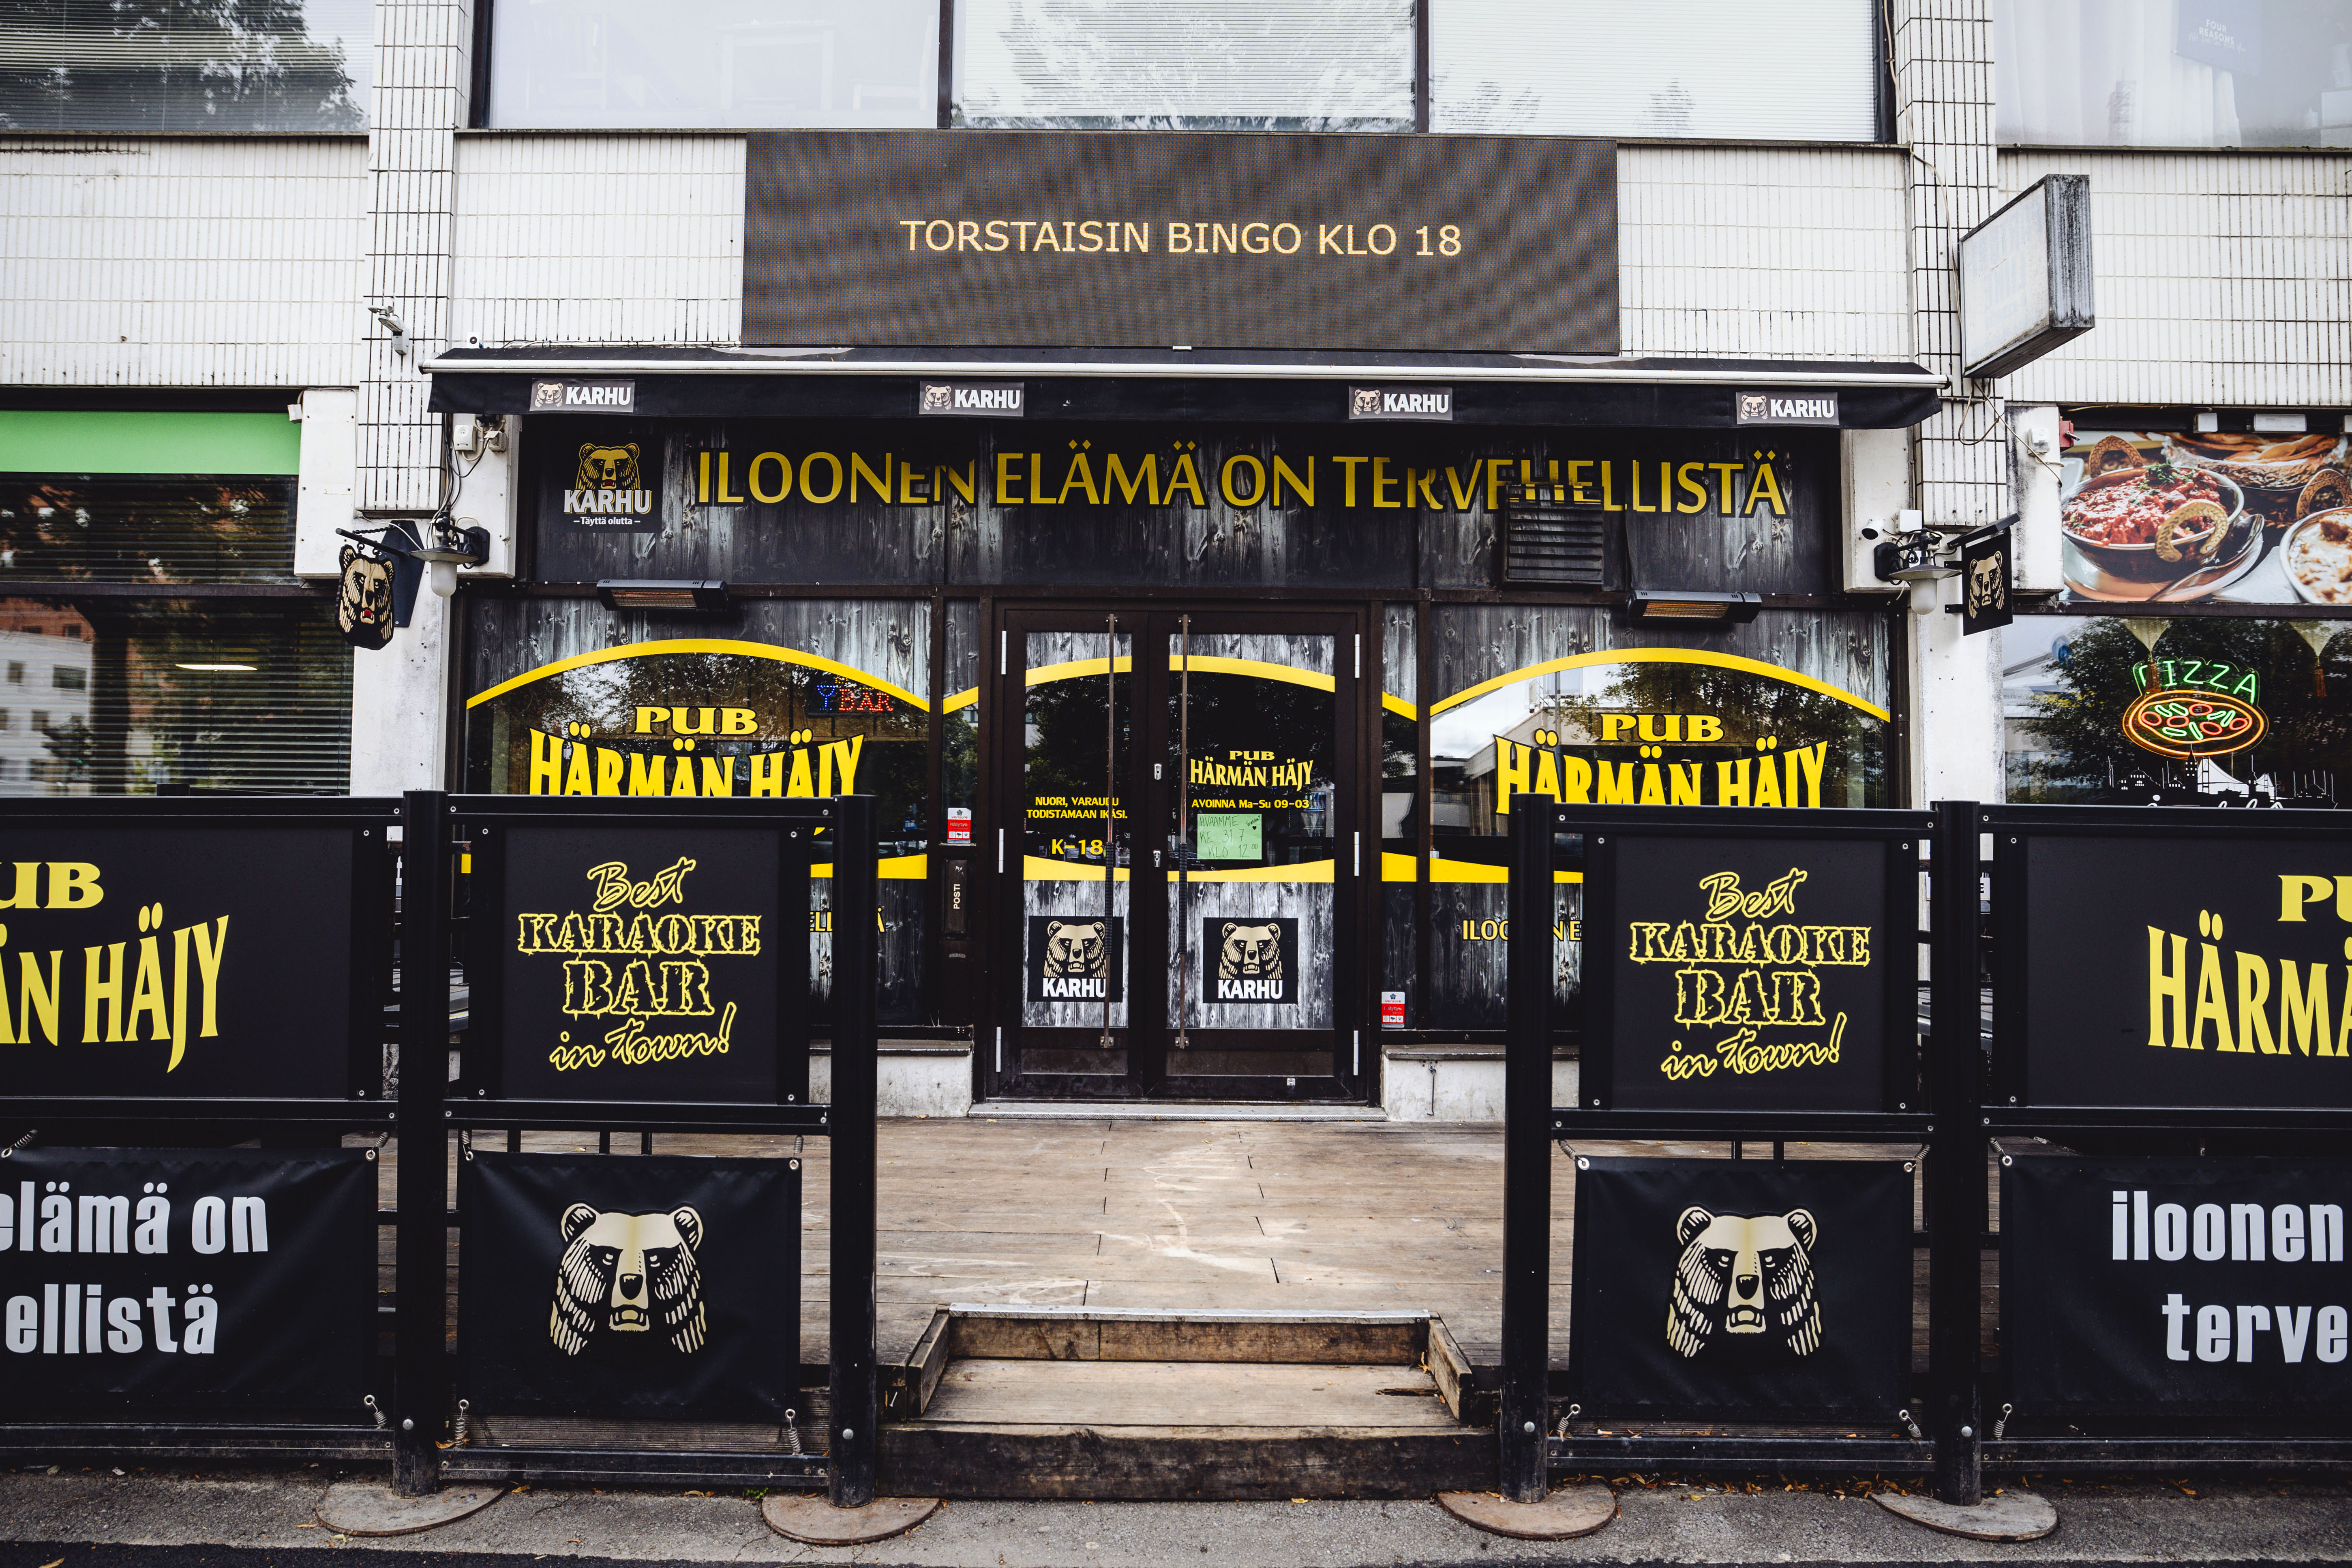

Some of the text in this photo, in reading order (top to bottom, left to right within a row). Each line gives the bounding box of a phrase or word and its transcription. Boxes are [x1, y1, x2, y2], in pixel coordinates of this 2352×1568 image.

[2199, 27, 2234, 45] REASONS
[2206, 19, 2227, 33] FOUR
[900, 219, 1462, 256] TORSTAISIN BINGO KLO 18
[565, 387, 631, 405] KARHU
[954, 389, 1021, 409] KARHU
[1384, 394, 1449, 413] KARHU
[1770, 399, 1835, 418] KARHU
[699, 451, 975, 503] ILOONEN
[996, 439, 1205, 506] ELÄMÄ
[1221, 454, 1315, 507] ON
[564, 490, 652, 514] KARHU
[839, 688, 894, 712] BAR
[635, 706, 758, 735] PUB
[1600, 713, 1724, 742] PUB
[529, 722, 734, 797] HÄRMÄN
[1229, 750, 1275, 760] PUB
[1190, 756, 1314, 792] HÄRMÄN HÄJY
[1495, 730, 1703, 814] HÄRMÄN
[1026, 809, 1097, 818] TODISTAMAAN
[1035, 797, 1069, 808] NUORI,
[1191, 799, 1310, 809] AVOINNA Ma-Su 09-03
[1200, 815, 1240, 827] AVAAMME
[1051, 838, 1103, 855] K-18
[1200, 829, 1244, 844] KE 31 7
[1208, 845, 1229, 858] KLO
[586, 856, 697, 913] Best
[1699, 867, 1808, 923] Best
[517, 910, 763, 957] KARAOKE
[1629, 919, 1872, 968] KARAOKE
[81, 902, 229, 1073] HÄJY
[561, 957, 715, 1021] BAR
[1042, 977, 1106, 998] KARHU
[1217, 979, 1283, 1000] KARHU
[1673, 968, 1827, 1030] BAR
[548, 1002, 737, 1071] in town!
[1660, 1011, 1848, 1081] in town!
[191, 1195, 268, 1255] on
[2112, 1190, 2343, 1262] iloonen
[5, 1283, 218, 1355] ellistä
[2161, 1293, 2348, 1363] terve
